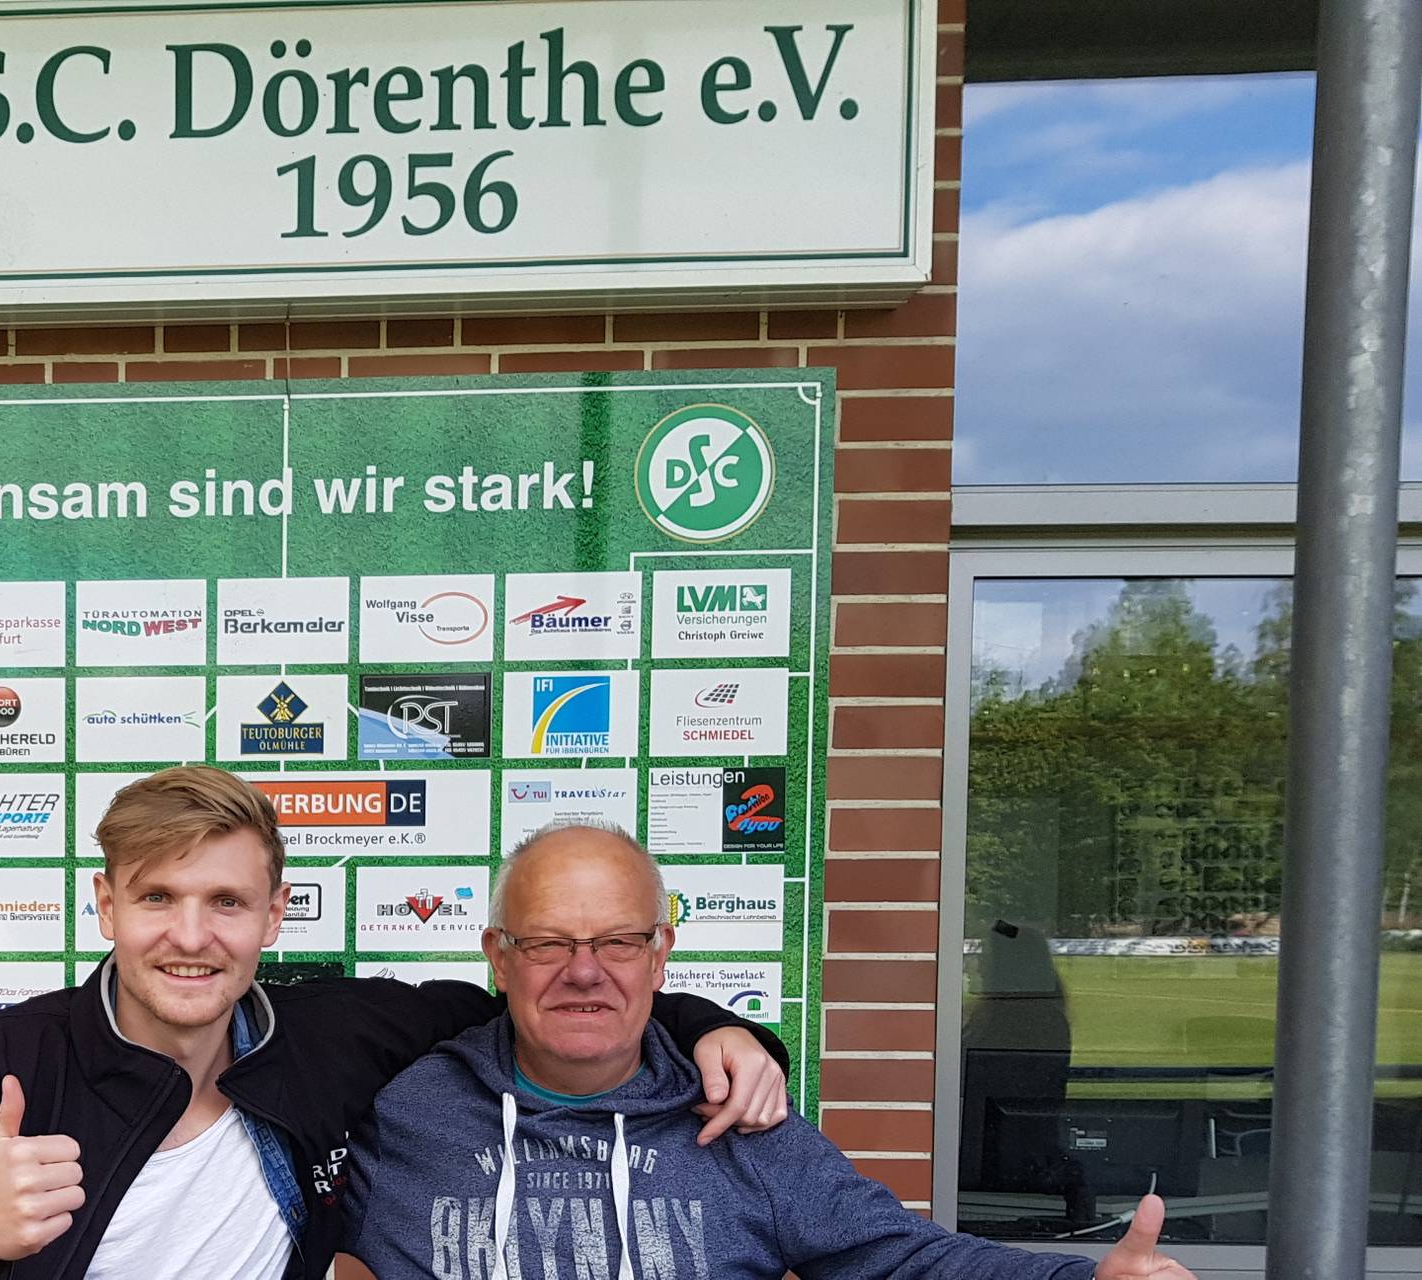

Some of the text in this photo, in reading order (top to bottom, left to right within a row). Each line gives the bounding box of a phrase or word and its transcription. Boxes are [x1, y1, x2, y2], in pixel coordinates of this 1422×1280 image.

[165, 27, 666, 139] Dörenthe
[700, 24, 860, 125] e.V.
[277, 150, 519, 239] 1956
[168, 467, 293, 518] sind
[313, 465, 404, 514] wir
[423, 460, 595, 513] stark!
[365, 599, 417, 610] Wolfgang
[676, 585, 737, 612] LVM
[82, 610, 202, 619] TÜRAUTOMATION
[224, 609, 255, 617] OPEL
[396, 611, 434, 623] Visse
[530, 613, 612, 629] Bäumer
[676, 613, 768, 626] Versicherungen
[224, 618, 345, 634] Berkemeier
[436, 625, 470, 633] Transporte
[678, 630, 764, 642] Christoph Greiwe
[536, 679, 554, 692] IFI
[87, 713, 182, 724] auto schüttken
[400, 700, 458, 735] RST
[676, 715, 763, 726] Fliesenzentrum
[0, 733, 56, 745] HERELD
[242, 726, 323, 740] TEUTOBURGER
[683, 730, 755, 741] SCHMIEDEL
[259, 740, 306, 751] ÖLMÜHLE
[546, 733, 609, 746] INITIATIVE
[546, 746, 609, 754] FÜR IBBENBÜREN
[650, 770, 745, 788] Leistungen
[532, 791, 547, 799] TUI
[389, 793, 422, 813] DE
[305, 832, 384, 847] Brockmeyer
[287, 893, 310, 905] ert
[696, 897, 776, 913] Berghaus
[432, 923, 484, 931] SERVICE
[719, 969, 766, 980] Suwelack
[706, 980, 751, 990] Partyservice
[475, 1134, 658, 1176] WILLIAMSBRG
[527, 1171, 611, 1190] SINCE 1971
